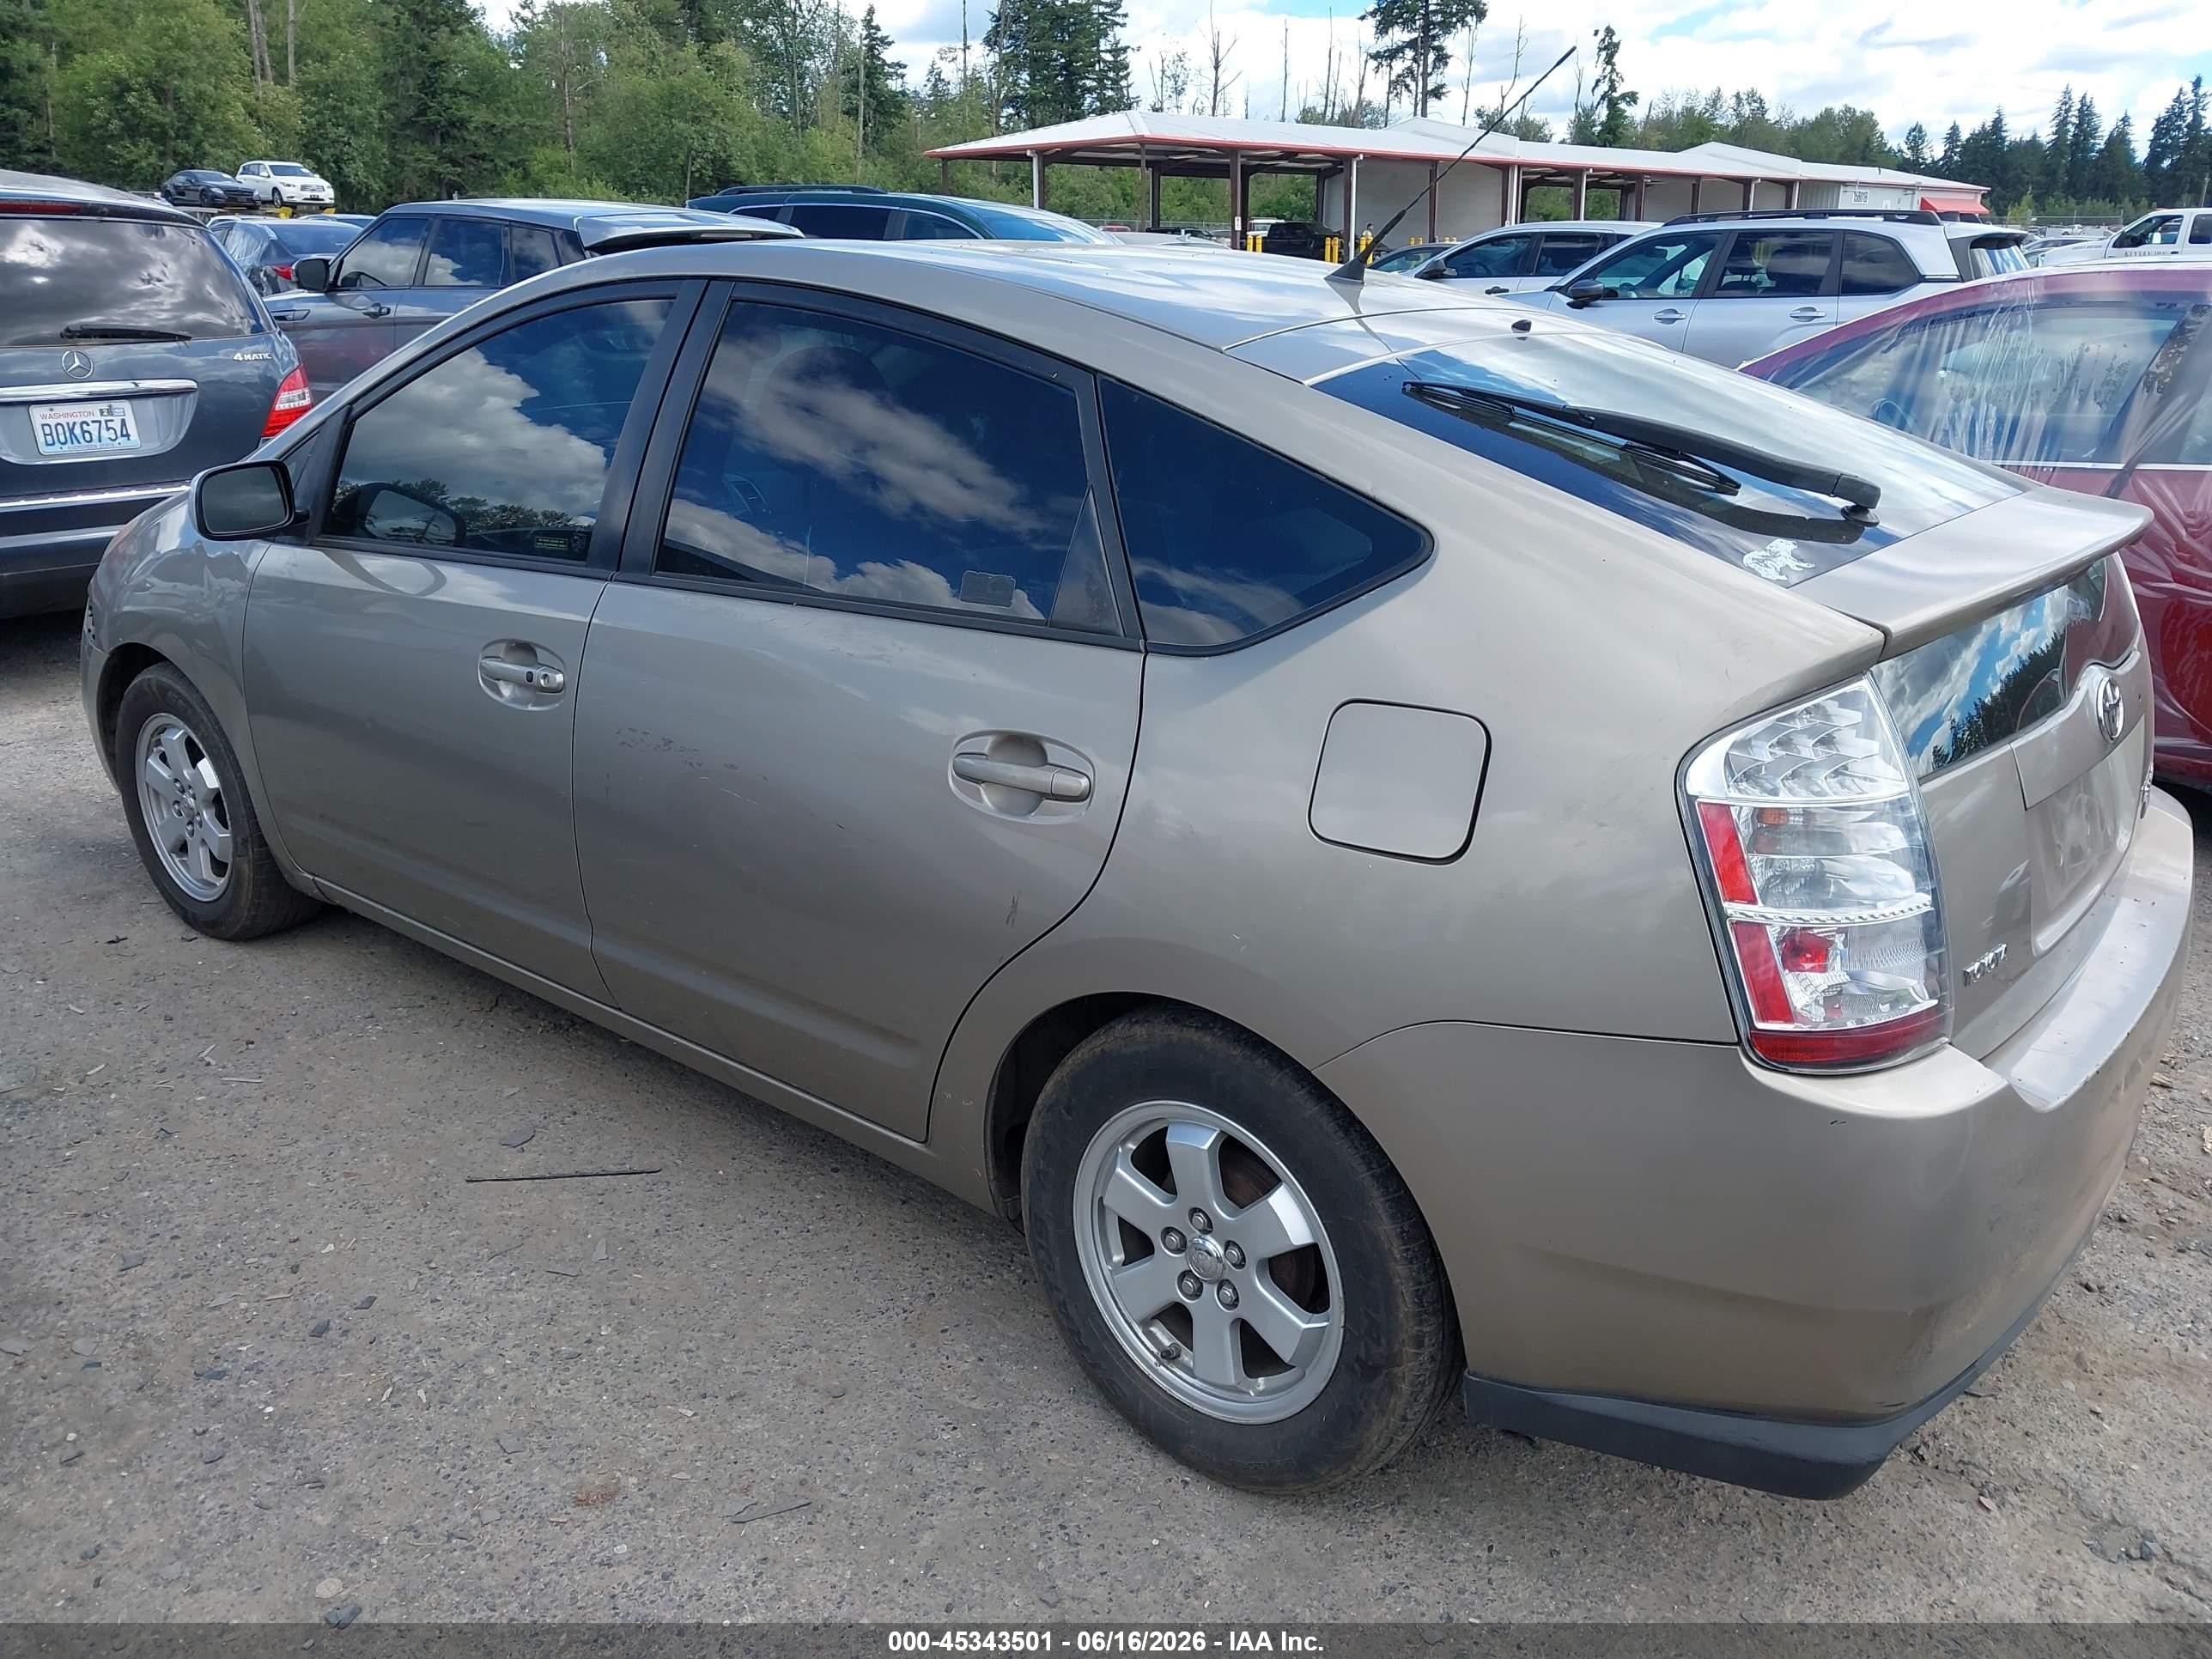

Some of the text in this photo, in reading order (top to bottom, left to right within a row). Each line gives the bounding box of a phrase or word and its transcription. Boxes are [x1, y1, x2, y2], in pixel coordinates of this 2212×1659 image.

[233, 352, 272, 361] 4MATIC
[40, 410, 94, 420] WASHINGTON
[40, 418, 131, 447] BOK6754
